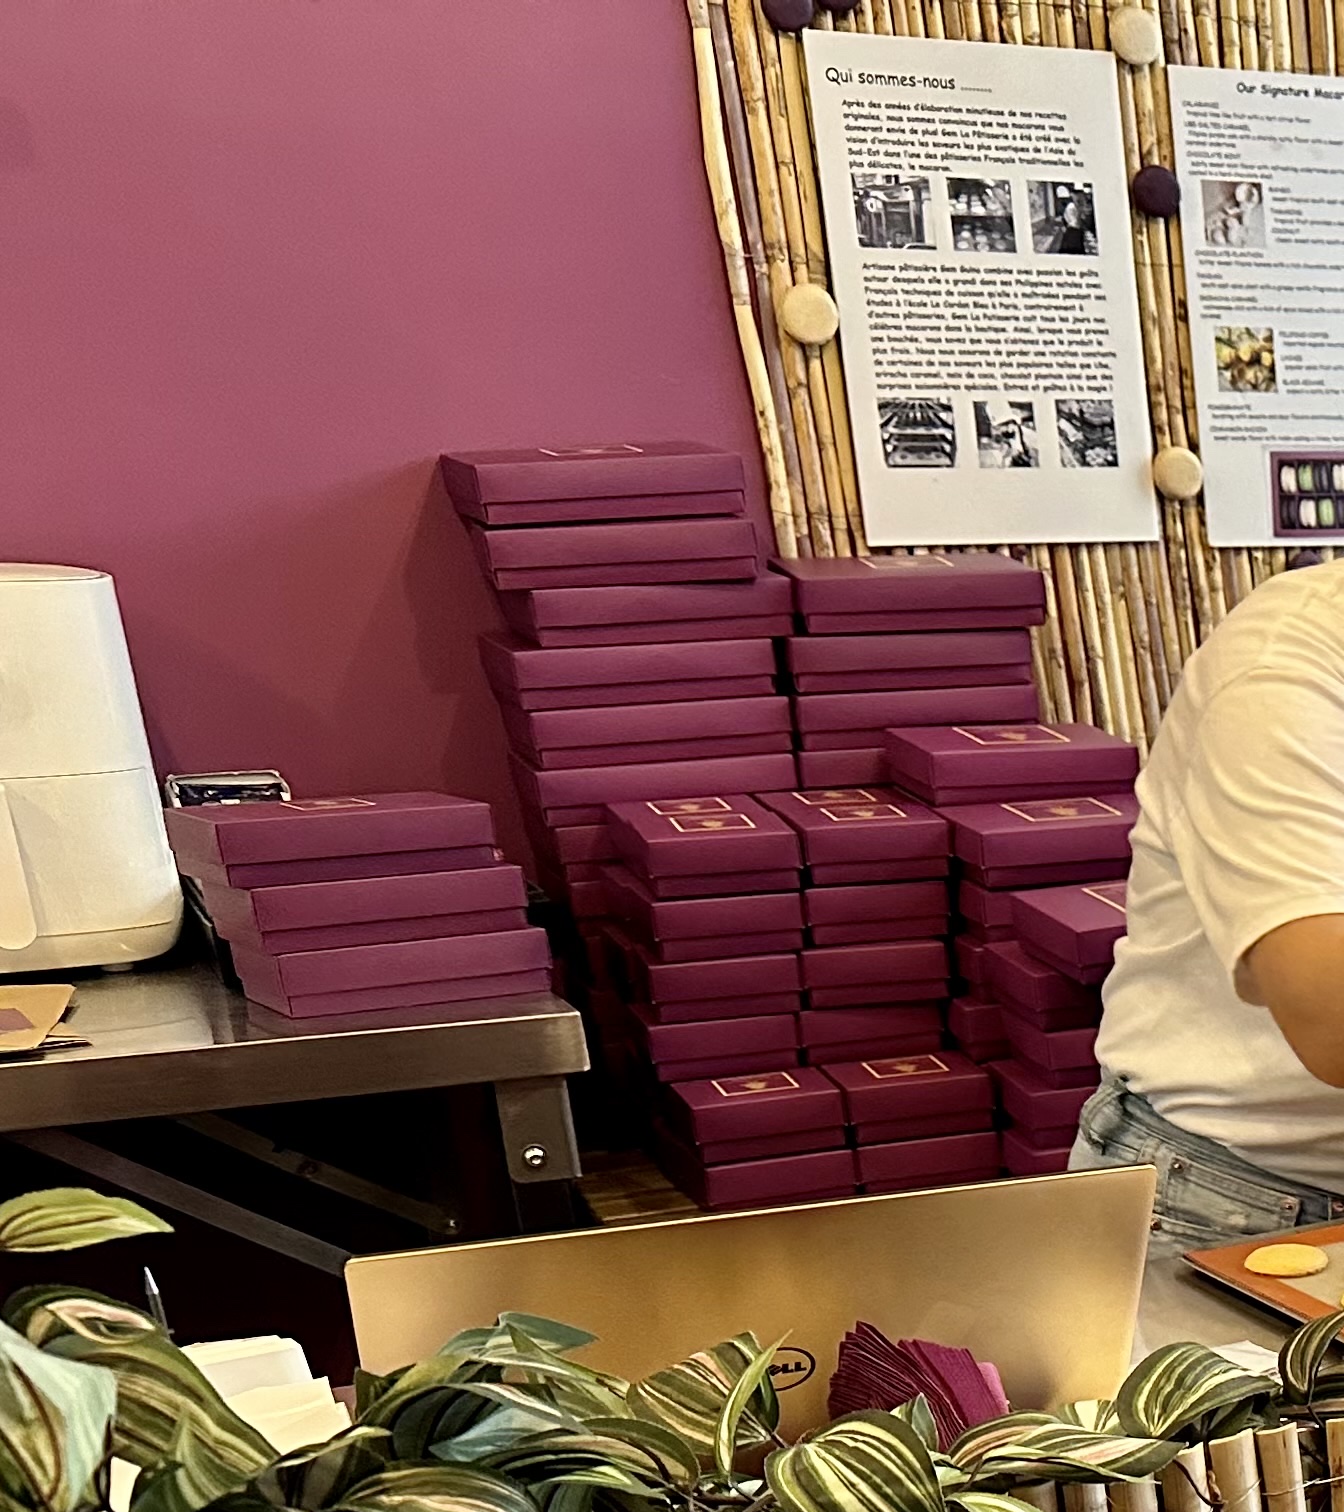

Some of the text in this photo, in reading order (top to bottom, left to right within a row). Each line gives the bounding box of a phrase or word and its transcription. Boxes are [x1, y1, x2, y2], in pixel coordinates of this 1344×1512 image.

[825, 67, 956, 90] Qui sommes-nous
[1236, 82, 1257, 94] Our
[1260, 84, 1309, 98] Signature
